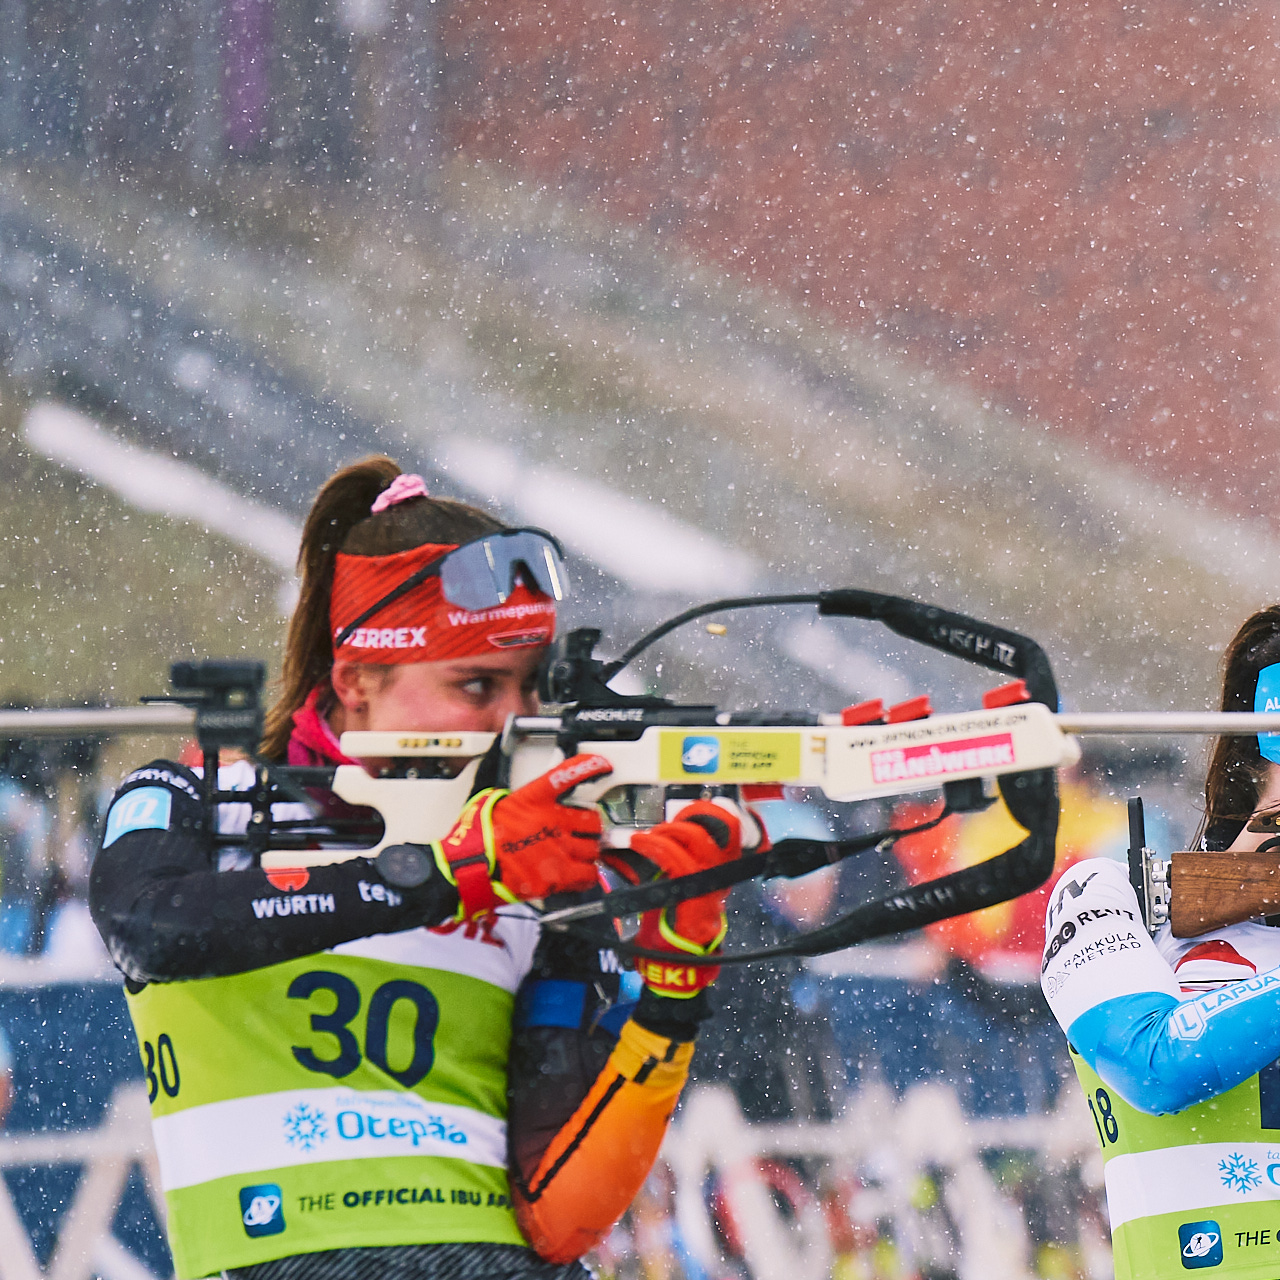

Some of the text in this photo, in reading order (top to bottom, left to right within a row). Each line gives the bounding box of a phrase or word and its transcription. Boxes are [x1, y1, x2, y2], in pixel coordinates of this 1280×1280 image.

[1063, 931, 1137, 970] RAIKKÜLA
[1074, 941, 1142, 970] METSAD
[1201, 974, 1280, 1012] LAPUA
[286, 970, 439, 1089] 30
[1089, 1087, 1119, 1149] 18
[298, 1193, 335, 1211] THE
[342, 1188, 445, 1208] OFFICIAL
[451, 1190, 481, 1206] IBU
[1235, 1229, 1271, 1247] THE
